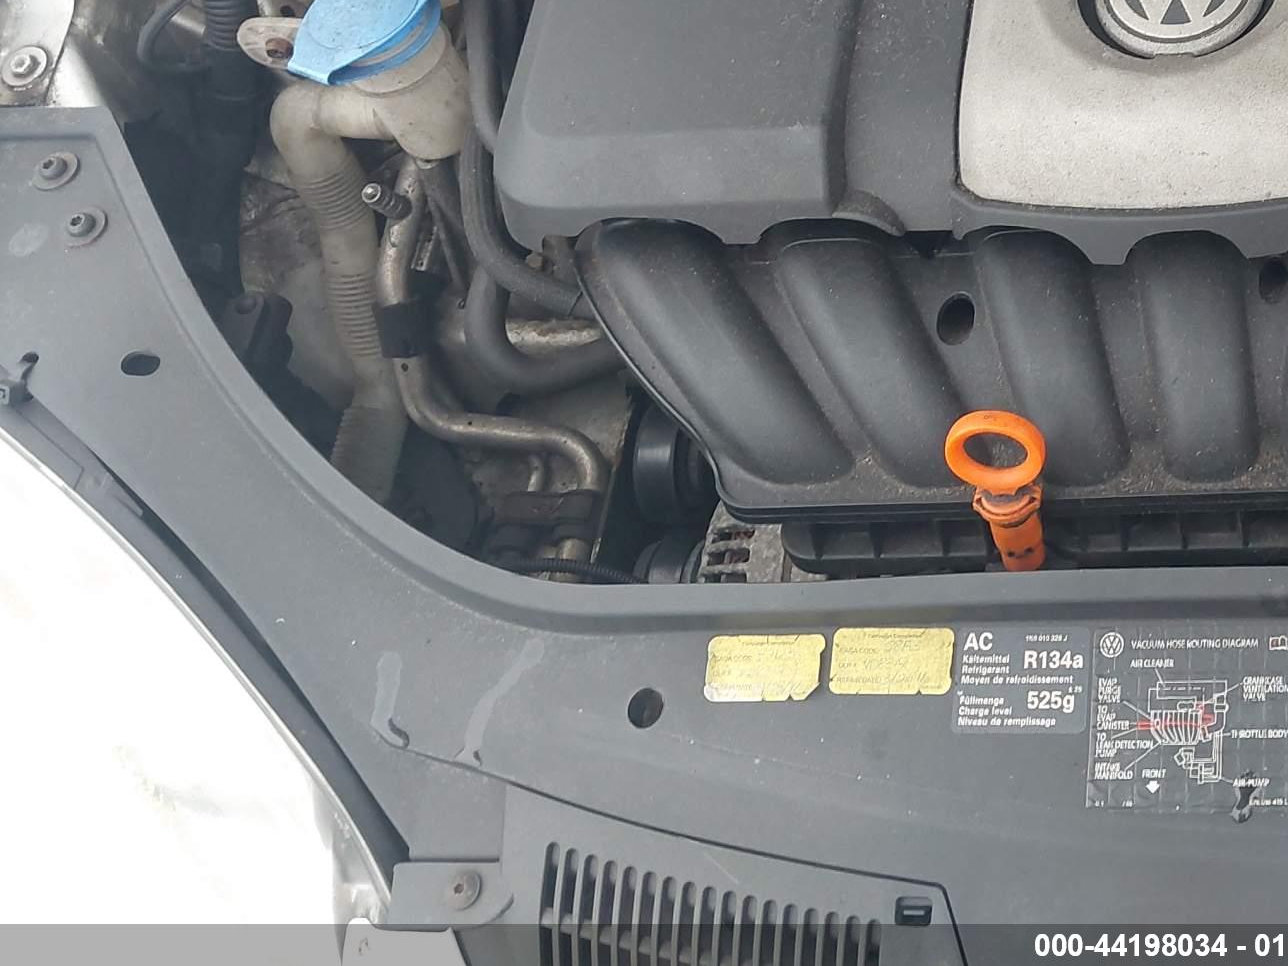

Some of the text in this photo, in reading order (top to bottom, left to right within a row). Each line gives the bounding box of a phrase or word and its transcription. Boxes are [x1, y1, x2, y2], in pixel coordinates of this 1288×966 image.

[964, 632, 992, 650] AC
[1132, 639, 1165, 649] VACUUM
[1166, 639, 1185, 649] HOSE
[1223, 639, 1258, 648] DIAGRAM
[1024, 650, 1083, 668] R134a
[1130, 659, 1142, 667] AIR
[961, 675, 990, 685] Moyen
[1027, 691, 1074, 713] 525g
[959, 706, 1012, 716] Charge level
[958, 717, 987, 725] Niveau
[990, 717, 1001, 726] de
[1142, 769, 1166, 778] FRONT
